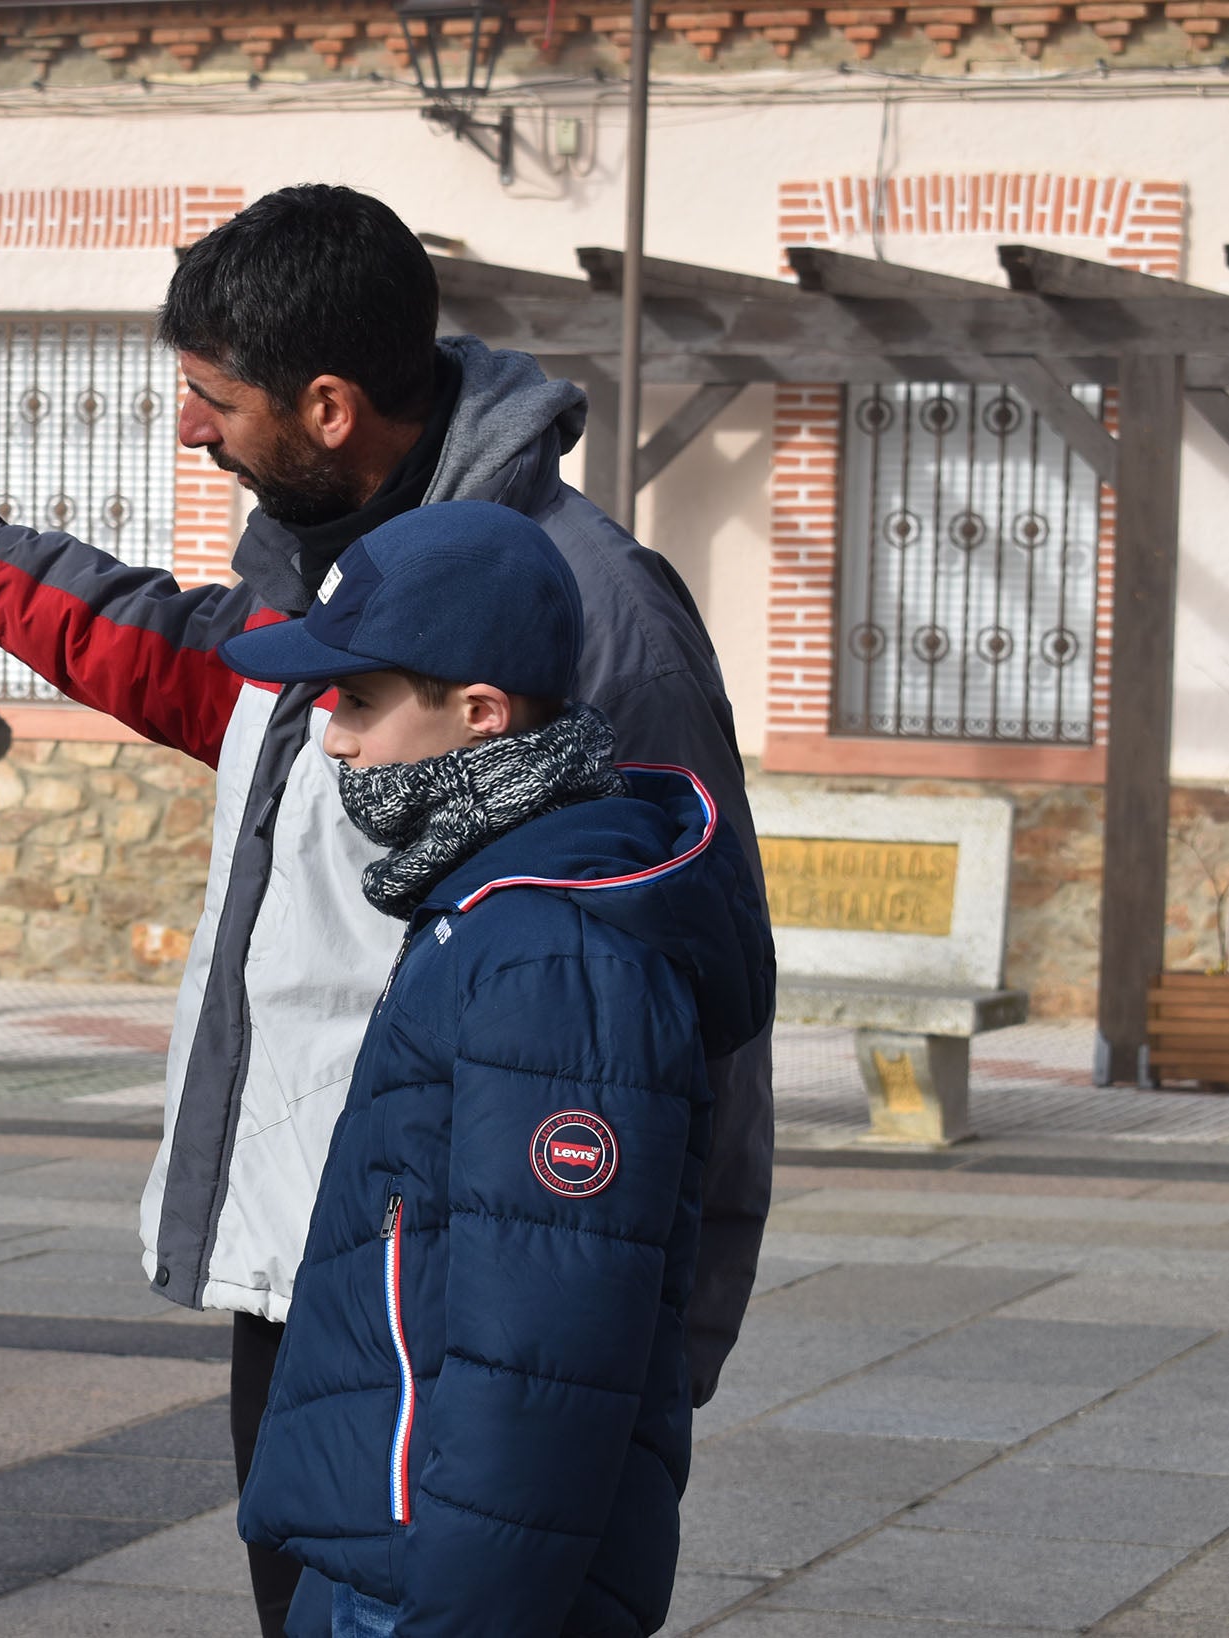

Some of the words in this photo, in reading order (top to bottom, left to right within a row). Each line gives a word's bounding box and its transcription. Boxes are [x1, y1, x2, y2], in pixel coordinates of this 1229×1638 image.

[802, 847, 947, 880] AHORROS
[769, 886, 924, 924] ALAMANCA
[539, 1124, 555, 1143] LEVI
[555, 1115, 597, 1129] STRAUSS
[597, 1128, 605, 1136] &
[536, 1152, 574, 1191] CALIFORNIA
[583, 1177, 599, 1190] EST
